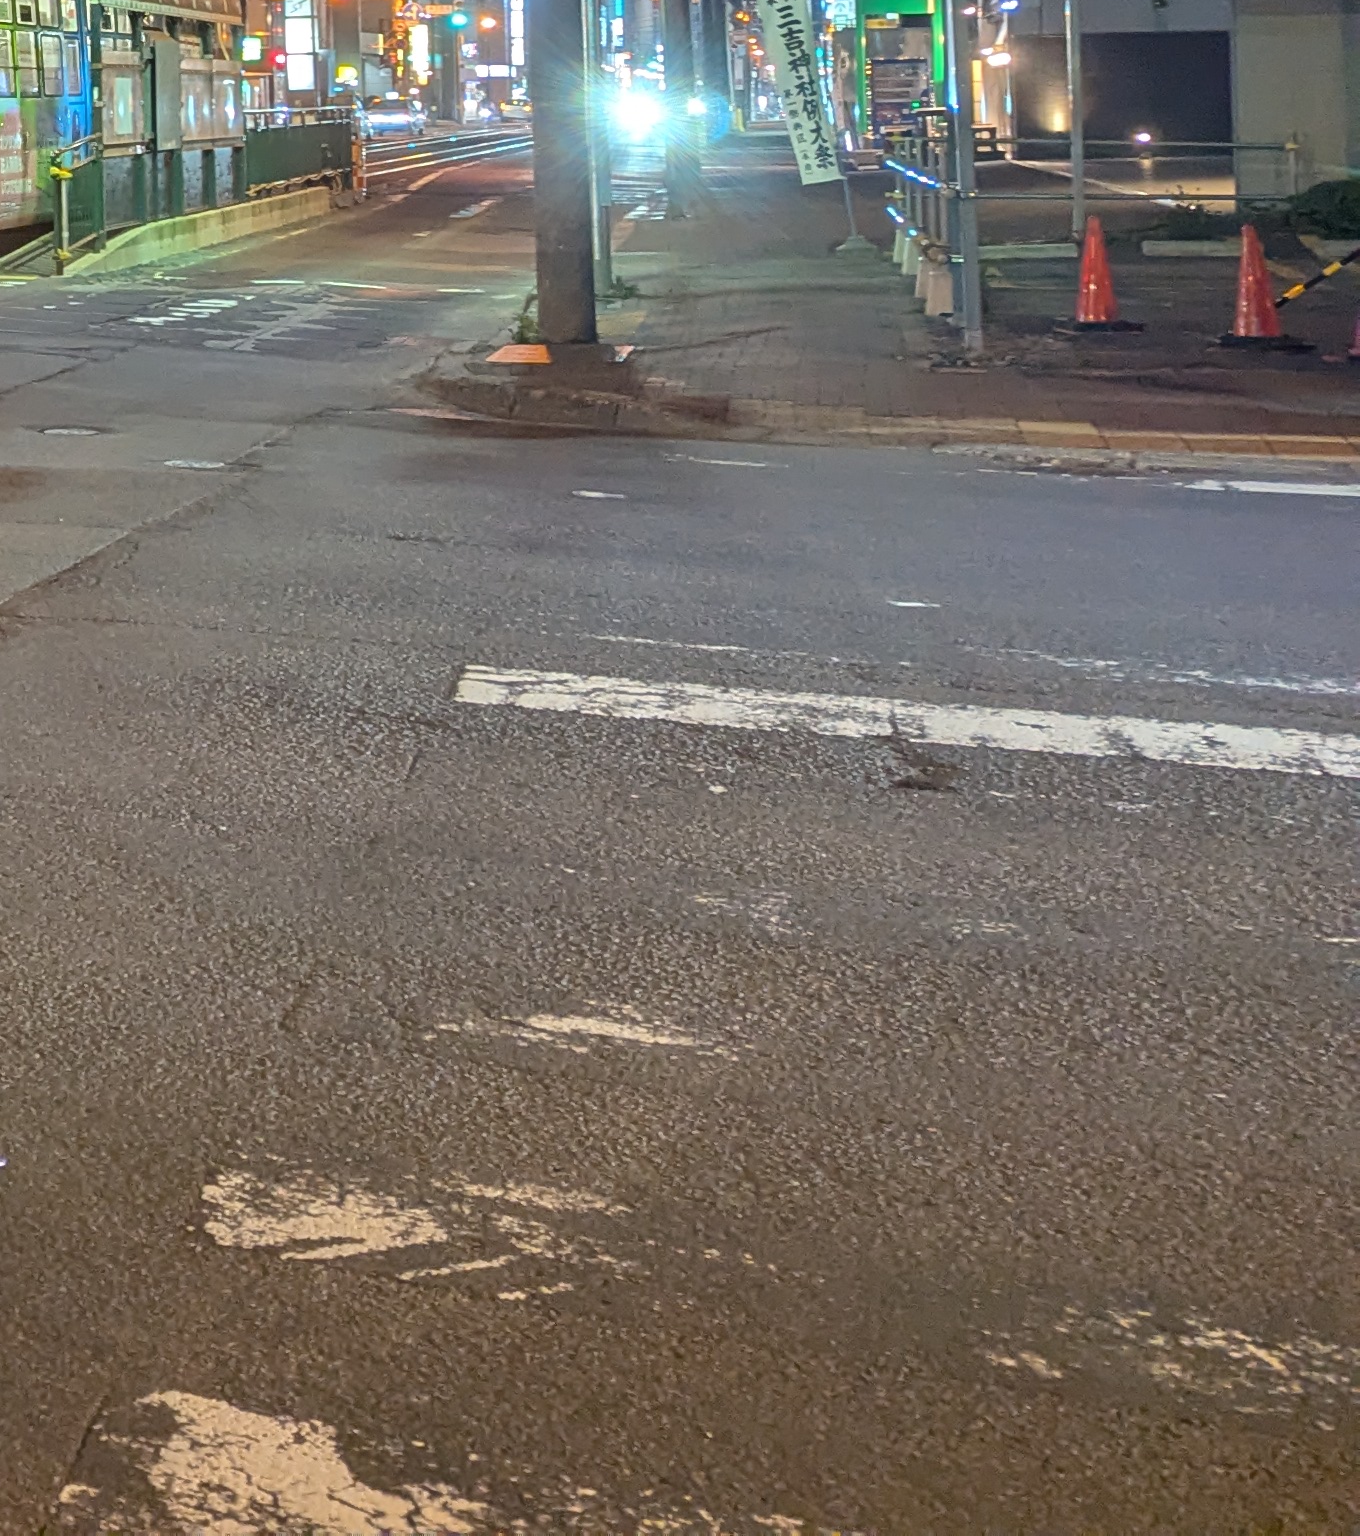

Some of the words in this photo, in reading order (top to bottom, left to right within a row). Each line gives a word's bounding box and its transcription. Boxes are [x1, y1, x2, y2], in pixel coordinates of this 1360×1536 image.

[776, 5, 835, 170] 三吉神社例大祭
